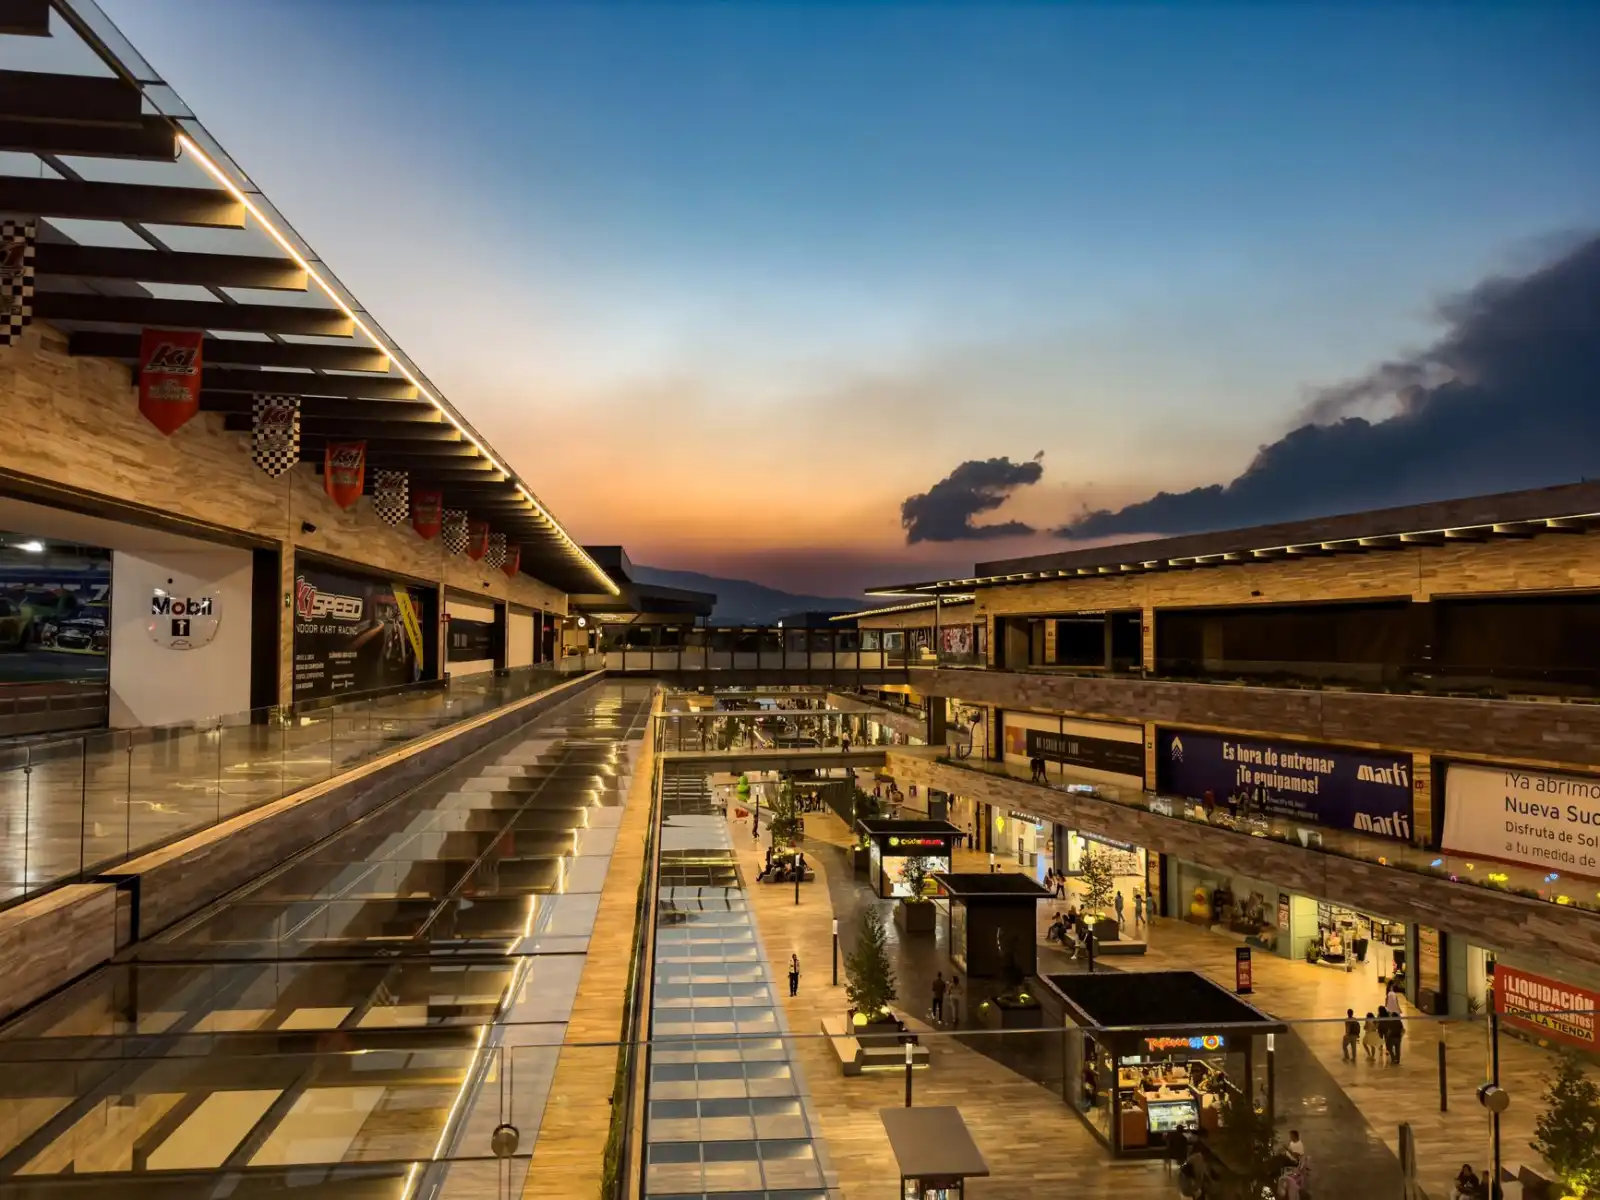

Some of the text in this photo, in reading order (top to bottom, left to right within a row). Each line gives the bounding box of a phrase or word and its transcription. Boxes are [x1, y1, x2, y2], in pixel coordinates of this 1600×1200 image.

[152, 597, 212, 615] Mobil
[312, 592, 363, 620] SPEED
[320, 625, 337, 634] KART
[1222, 742, 1335, 775] Es hora de entrenar
[1236, 764, 1319, 795] ¡Te equipamos!
[1536, 776, 1600, 799] abrimo
[1505, 796, 1600, 826] Nueva Suc
[1505, 821, 1599, 848] Disfruta de Sol
[1505, 841, 1596, 868] a tu medida de
[1503, 974, 1595, 1017] ¡LIQUIDACIÓN
[1505, 992, 1528, 1008] TOTAL
[1529, 999, 1539, 1012] DE
[1505, 1005, 1593, 1040] TOA LA TIENDA
